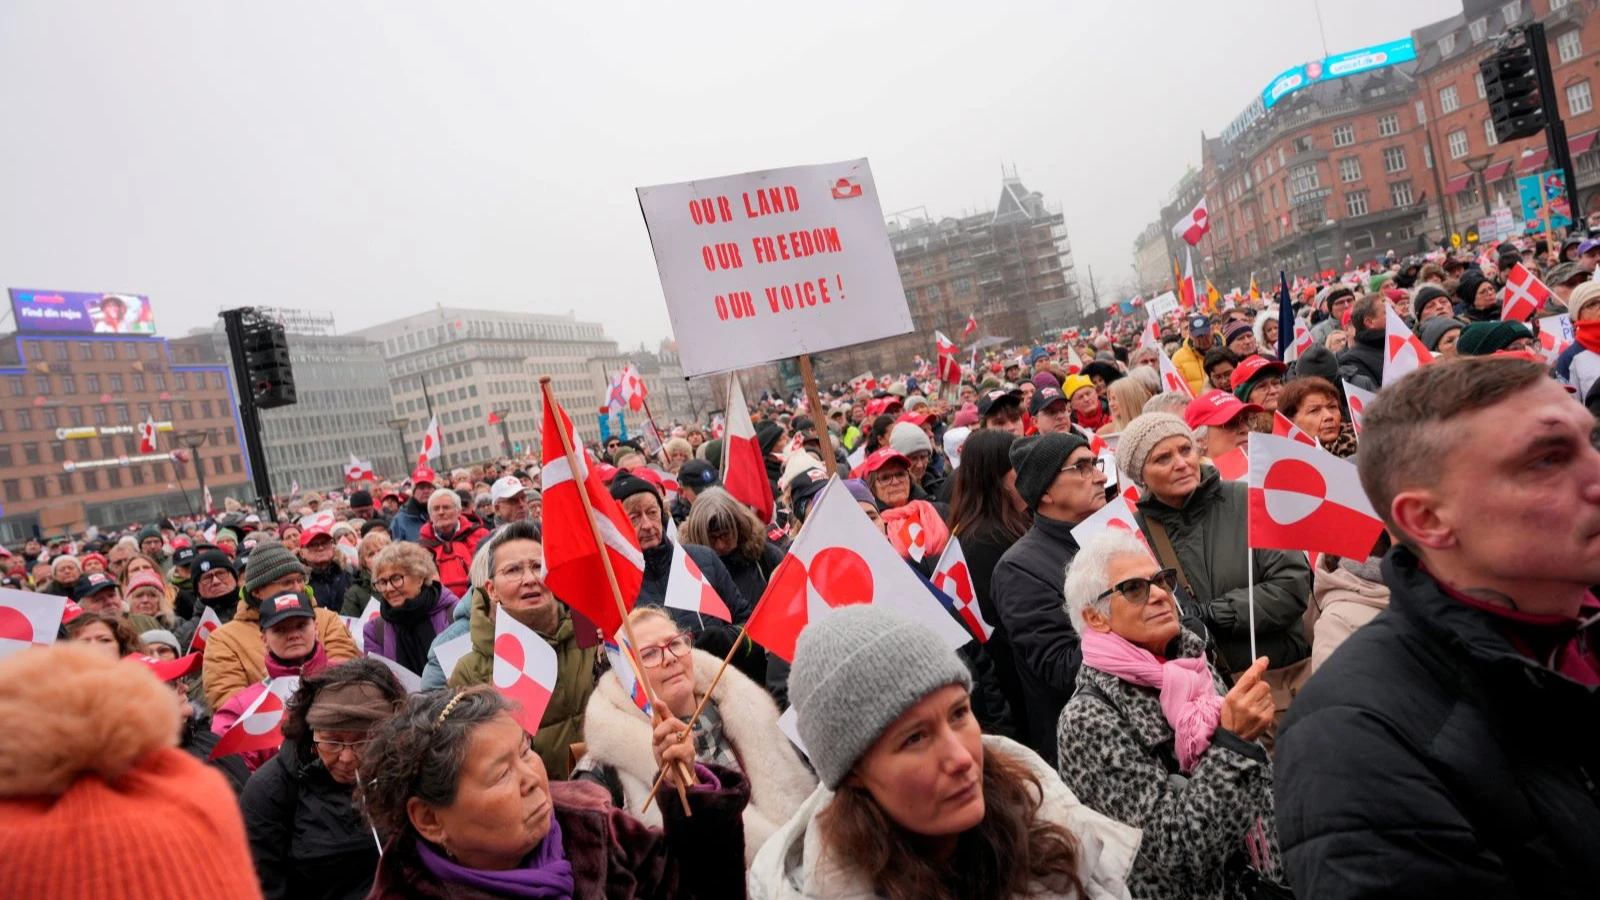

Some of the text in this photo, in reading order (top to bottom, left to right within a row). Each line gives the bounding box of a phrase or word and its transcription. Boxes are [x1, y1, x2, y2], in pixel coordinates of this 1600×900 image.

[689, 186, 798, 225] OUR LAND
[702, 227, 842, 270] OUR FREEDOM
[21, 307, 82, 319] Find din rejse
[715, 291, 755, 320] OUR
